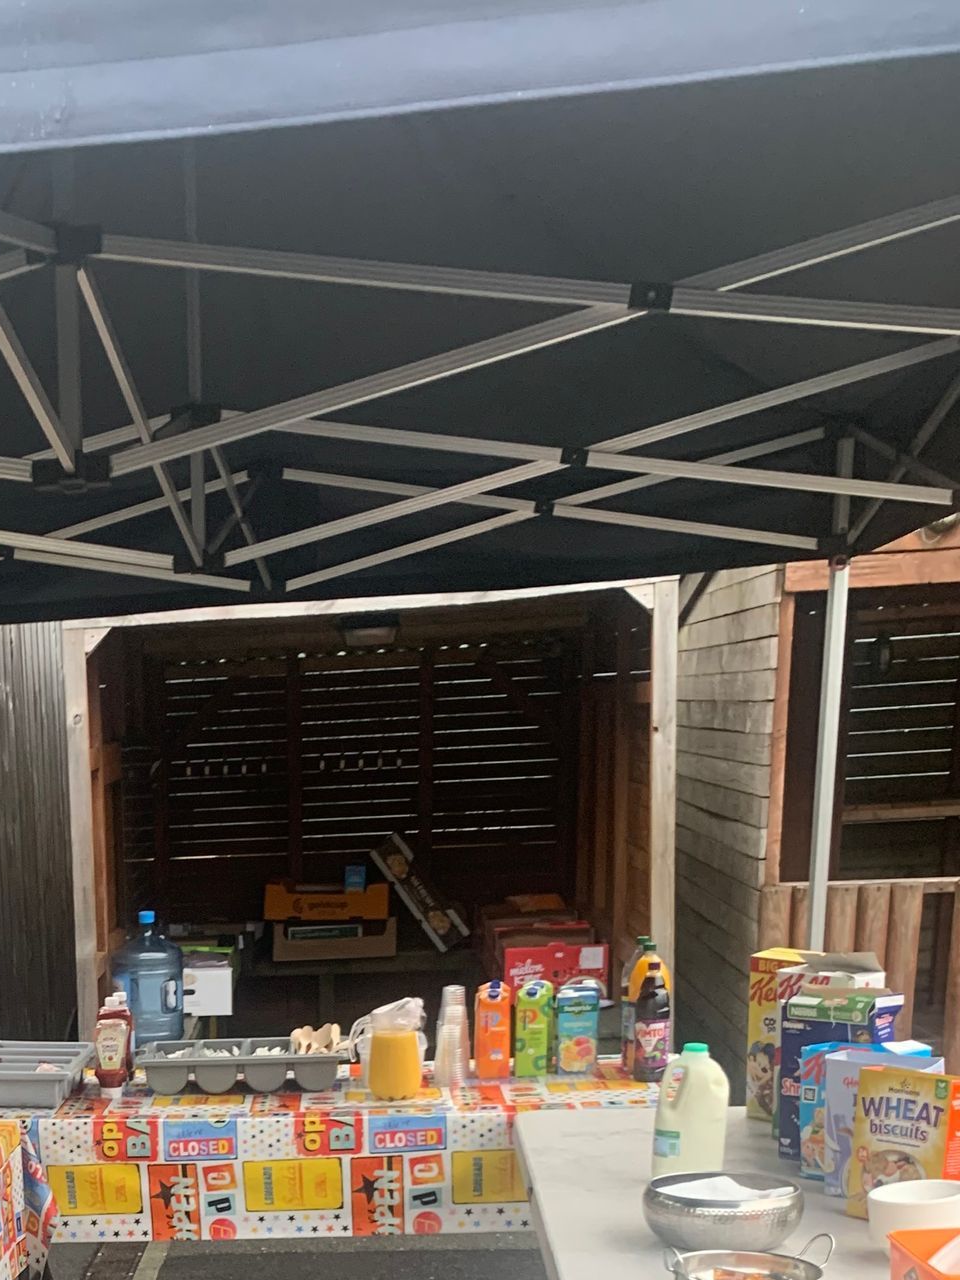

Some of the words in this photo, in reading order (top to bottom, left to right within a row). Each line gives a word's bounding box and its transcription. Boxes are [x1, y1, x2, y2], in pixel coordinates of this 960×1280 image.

[862, 1096, 944, 1128] WHEAT
[374, 1131, 438, 1149] CLOSED
[870, 1119, 928, 1142] biscuits
[169, 1138, 231, 1158] CLOSED
